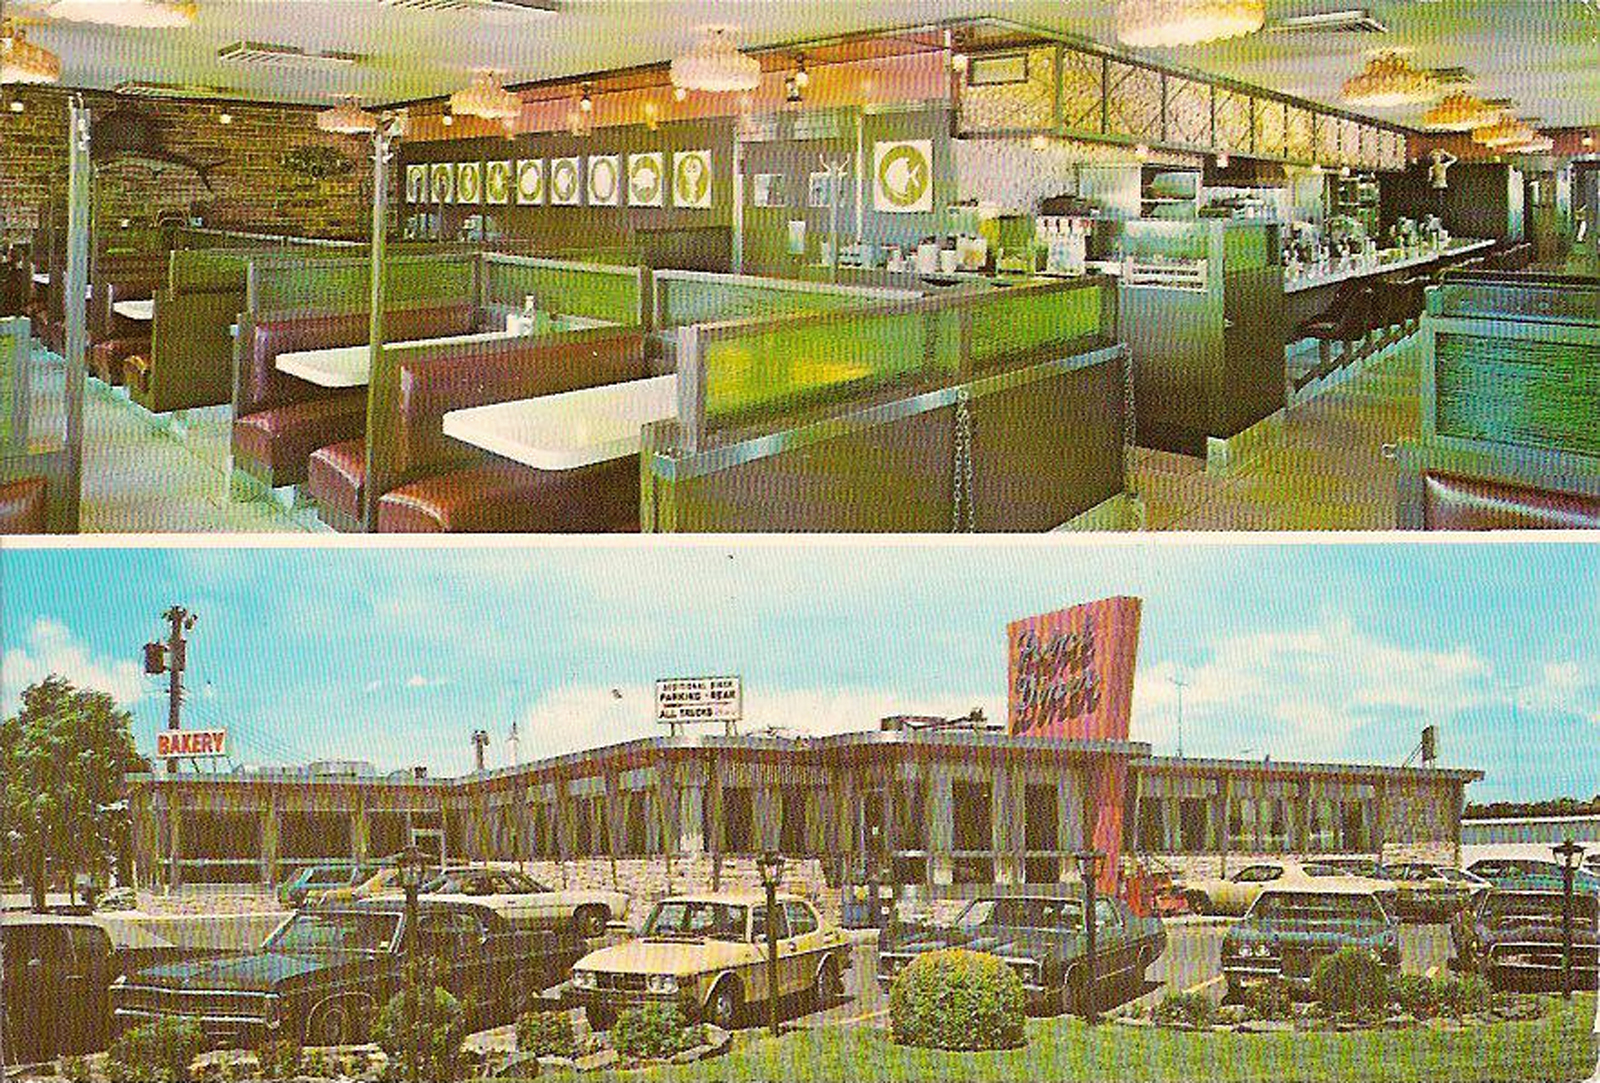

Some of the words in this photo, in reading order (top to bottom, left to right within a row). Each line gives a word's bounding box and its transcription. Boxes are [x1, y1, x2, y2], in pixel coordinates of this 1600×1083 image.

[660, 692, 701, 701] PARKING
[711, 691, 736, 700] REAR
[659, 710, 677, 719] ALL
[680, 708, 713, 717] TRUCKS
[158, 732, 224, 755] BAKERY
